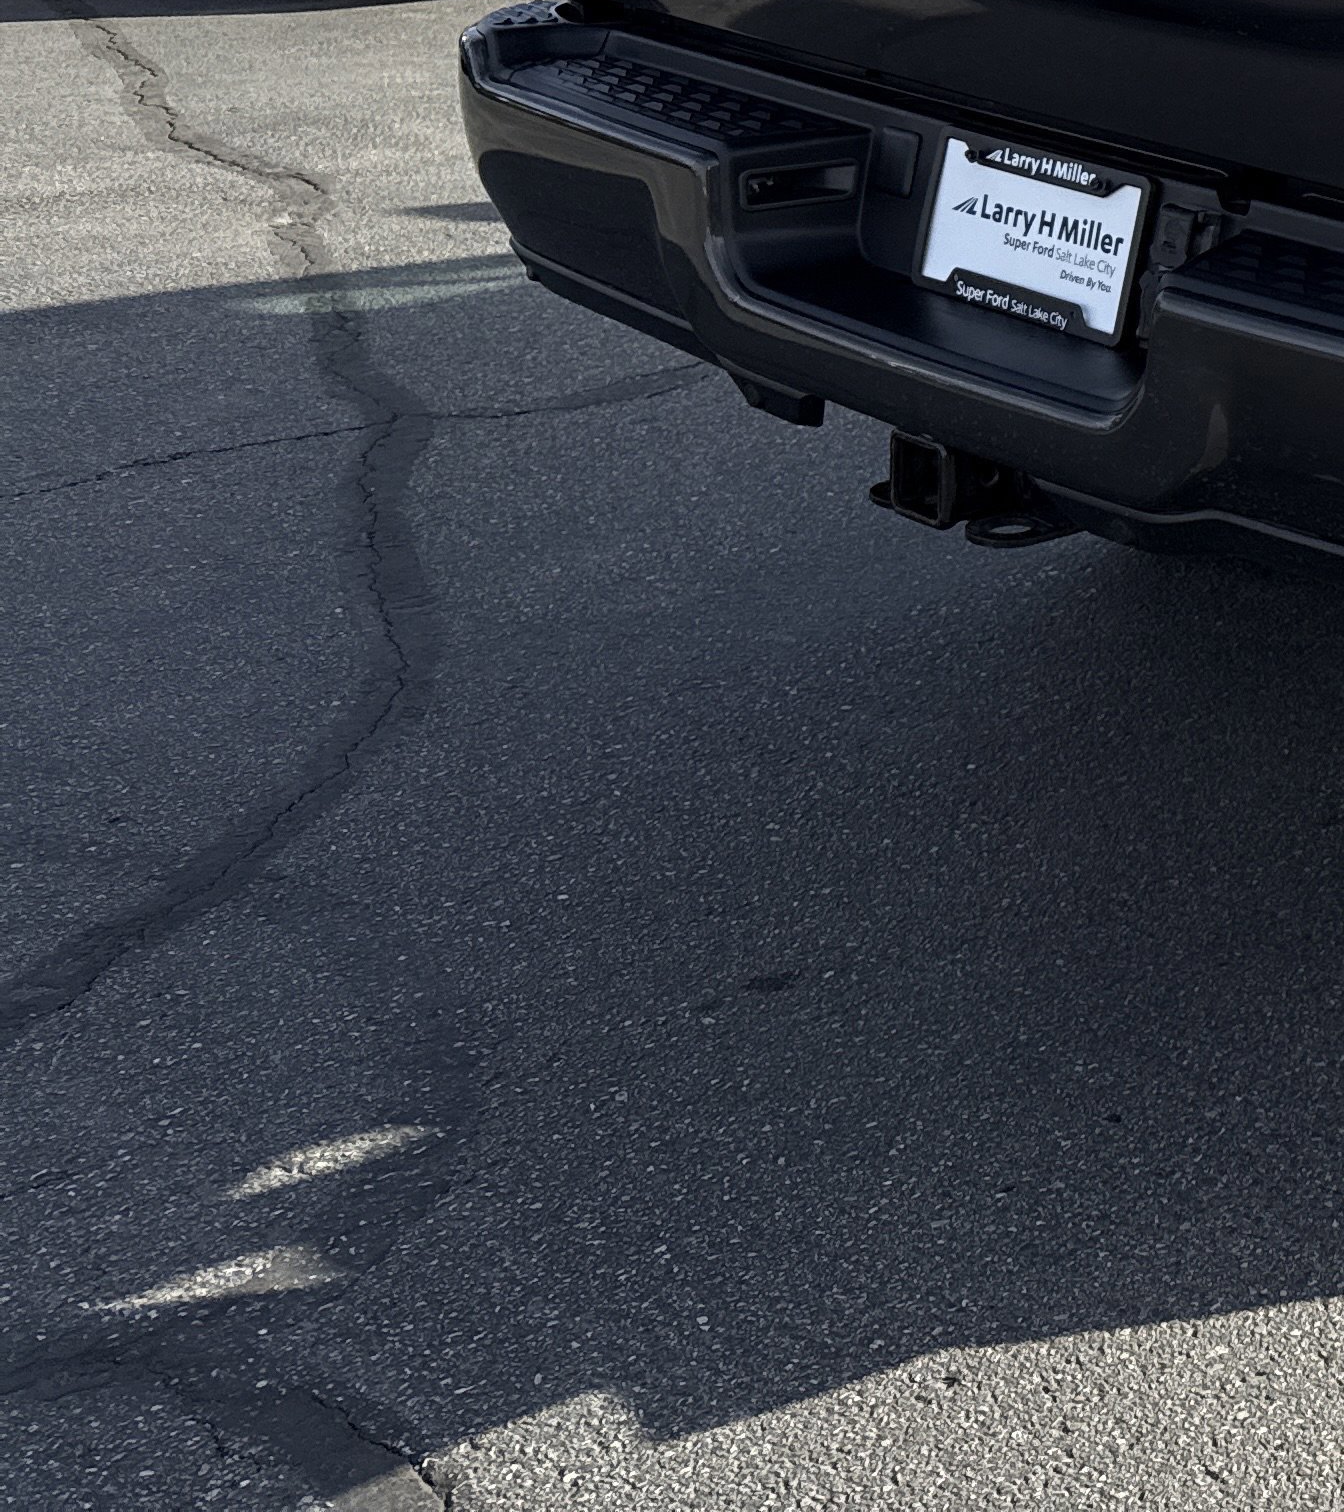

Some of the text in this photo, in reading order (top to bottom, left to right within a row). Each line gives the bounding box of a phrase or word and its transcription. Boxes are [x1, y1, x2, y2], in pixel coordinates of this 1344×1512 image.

[1004, 147, 1097, 187] Larry H Miller
[980, 194, 1124, 256] Larry H Miller
[1003, 233, 1116, 278] Super Ford Salt Lake City
[1060, 270, 1085, 285] Driven
[1086, 276, 1096, 291] By
[955, 280, 1068, 331] Super Ford Salt Lake City
